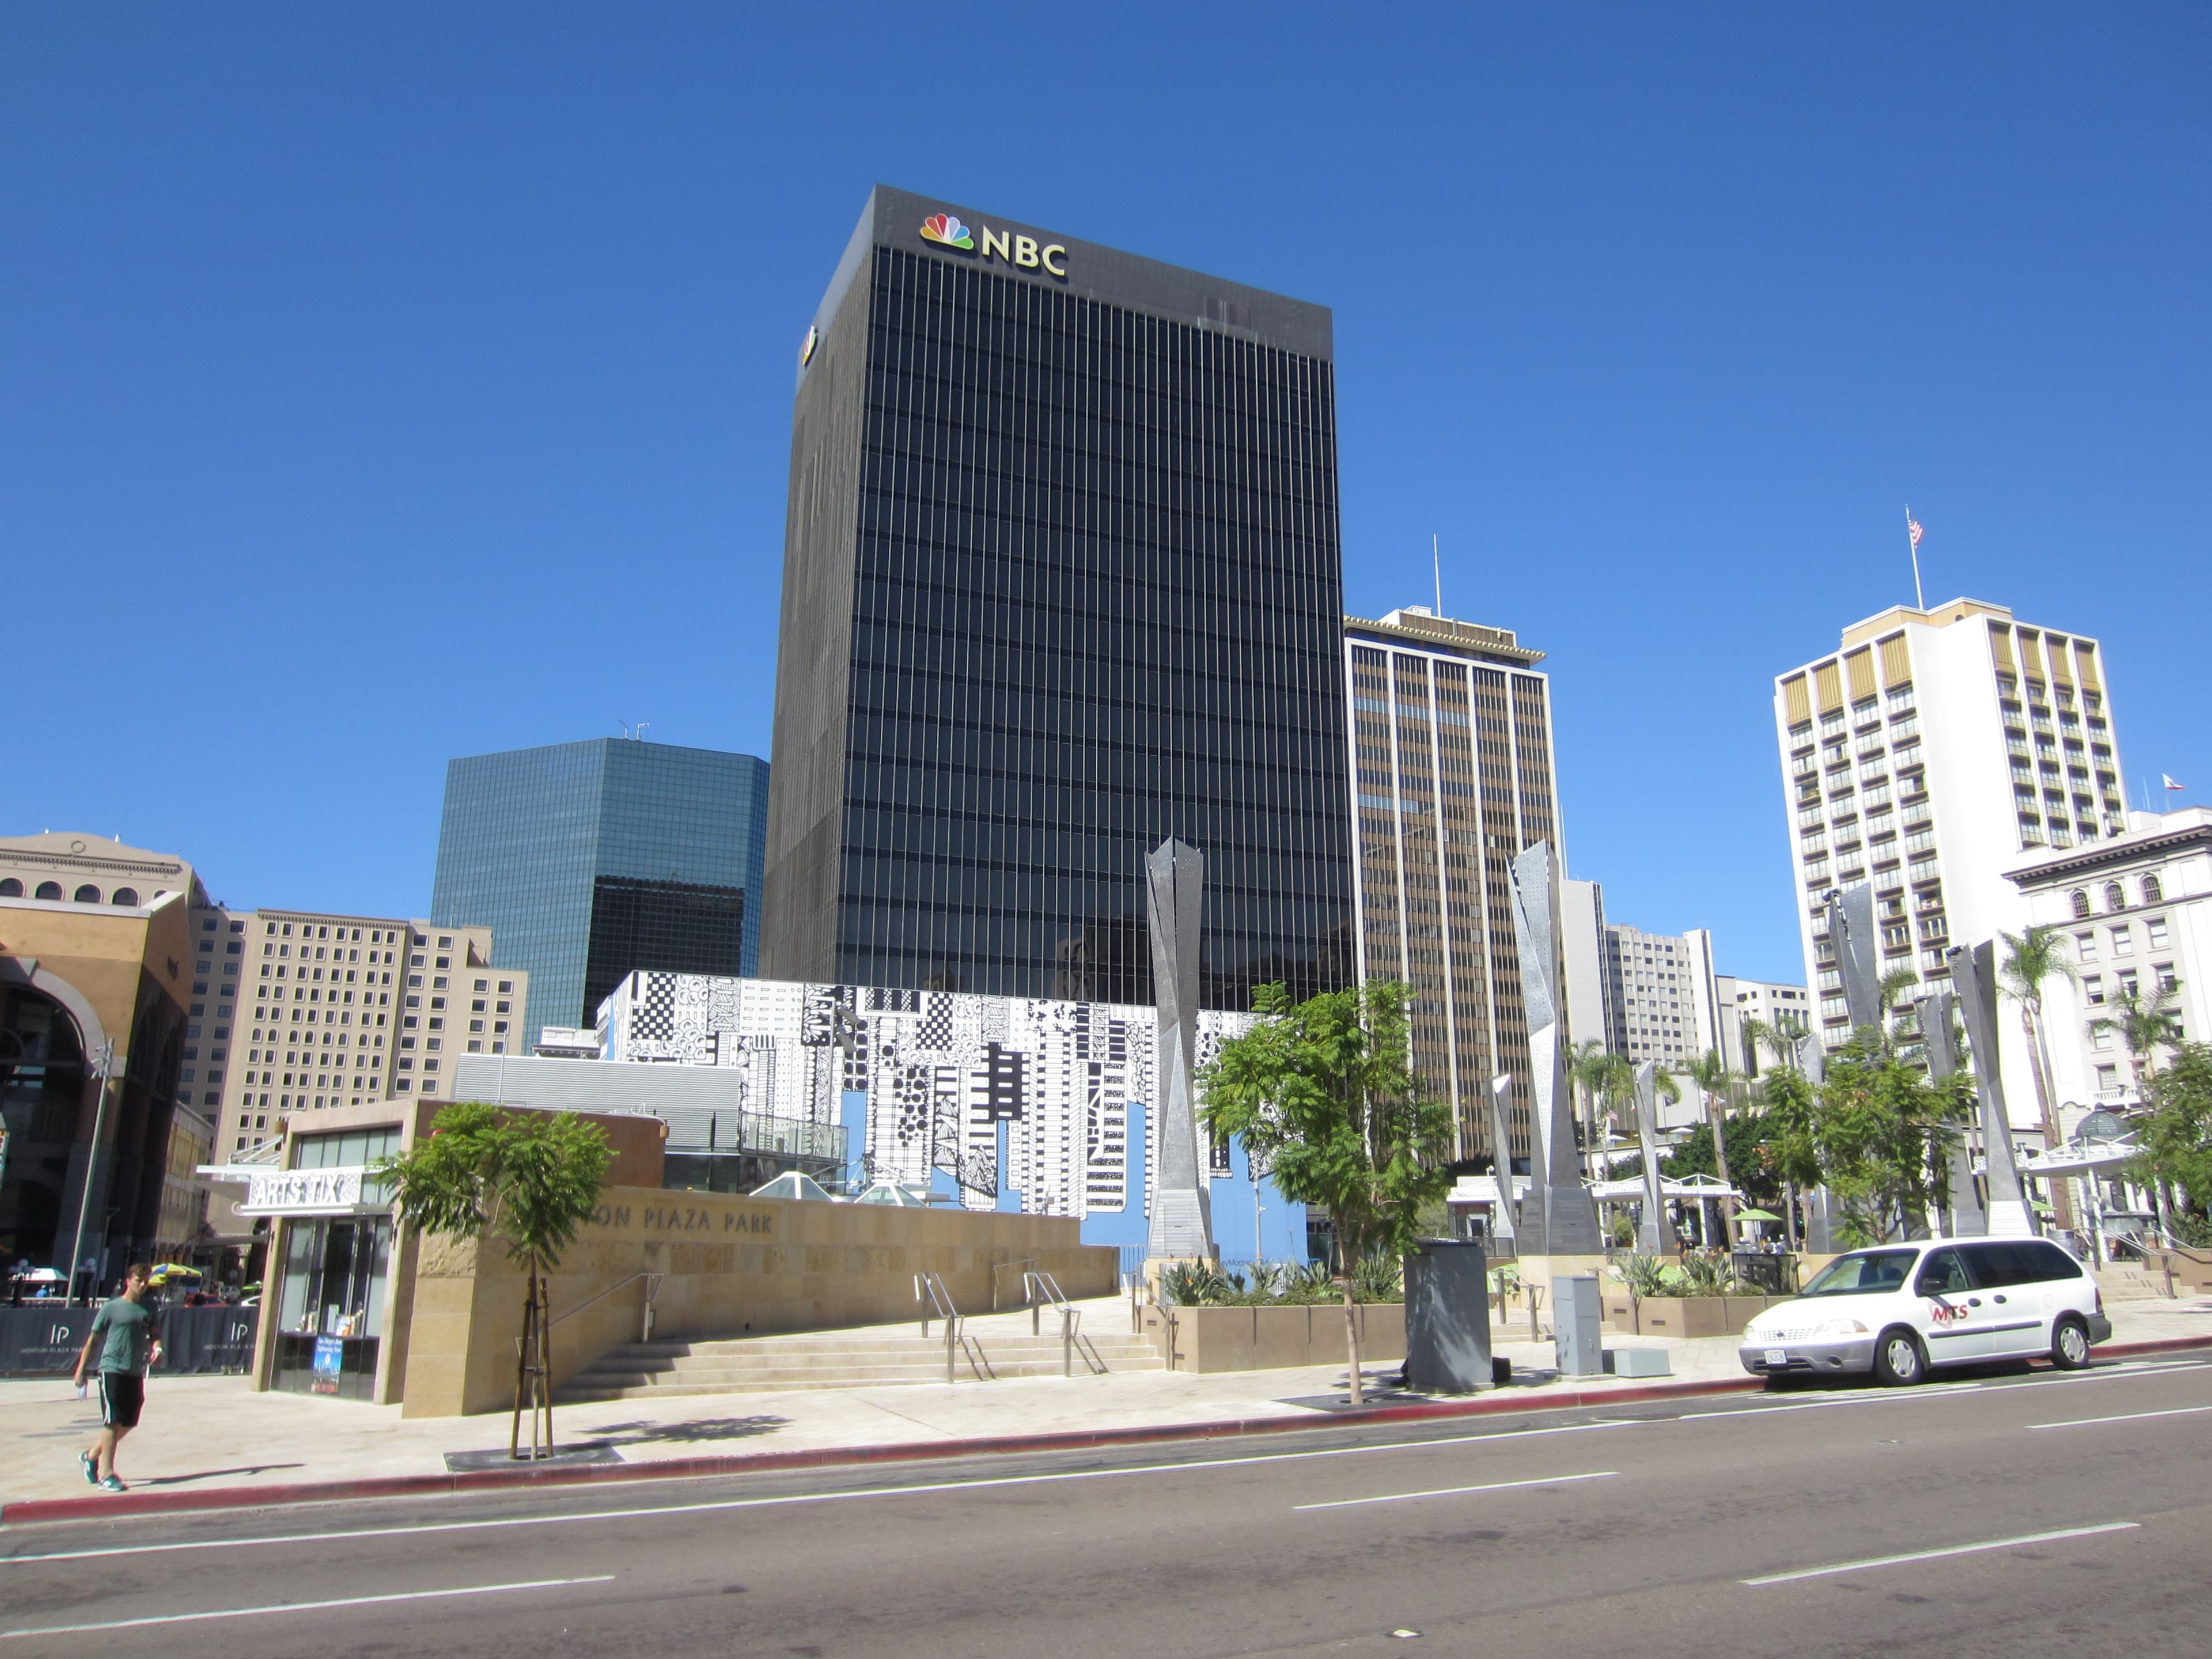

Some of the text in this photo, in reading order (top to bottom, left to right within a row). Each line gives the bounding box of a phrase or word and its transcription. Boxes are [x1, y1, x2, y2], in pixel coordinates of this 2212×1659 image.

[982, 225, 1066, 276] NBC
[257, 1173, 343, 1206] ARTS TIX
[644, 1207, 711, 1231] PLAZA
[724, 1212, 772, 1233] PARK
[1932, 1305, 1968, 1321] MTS
